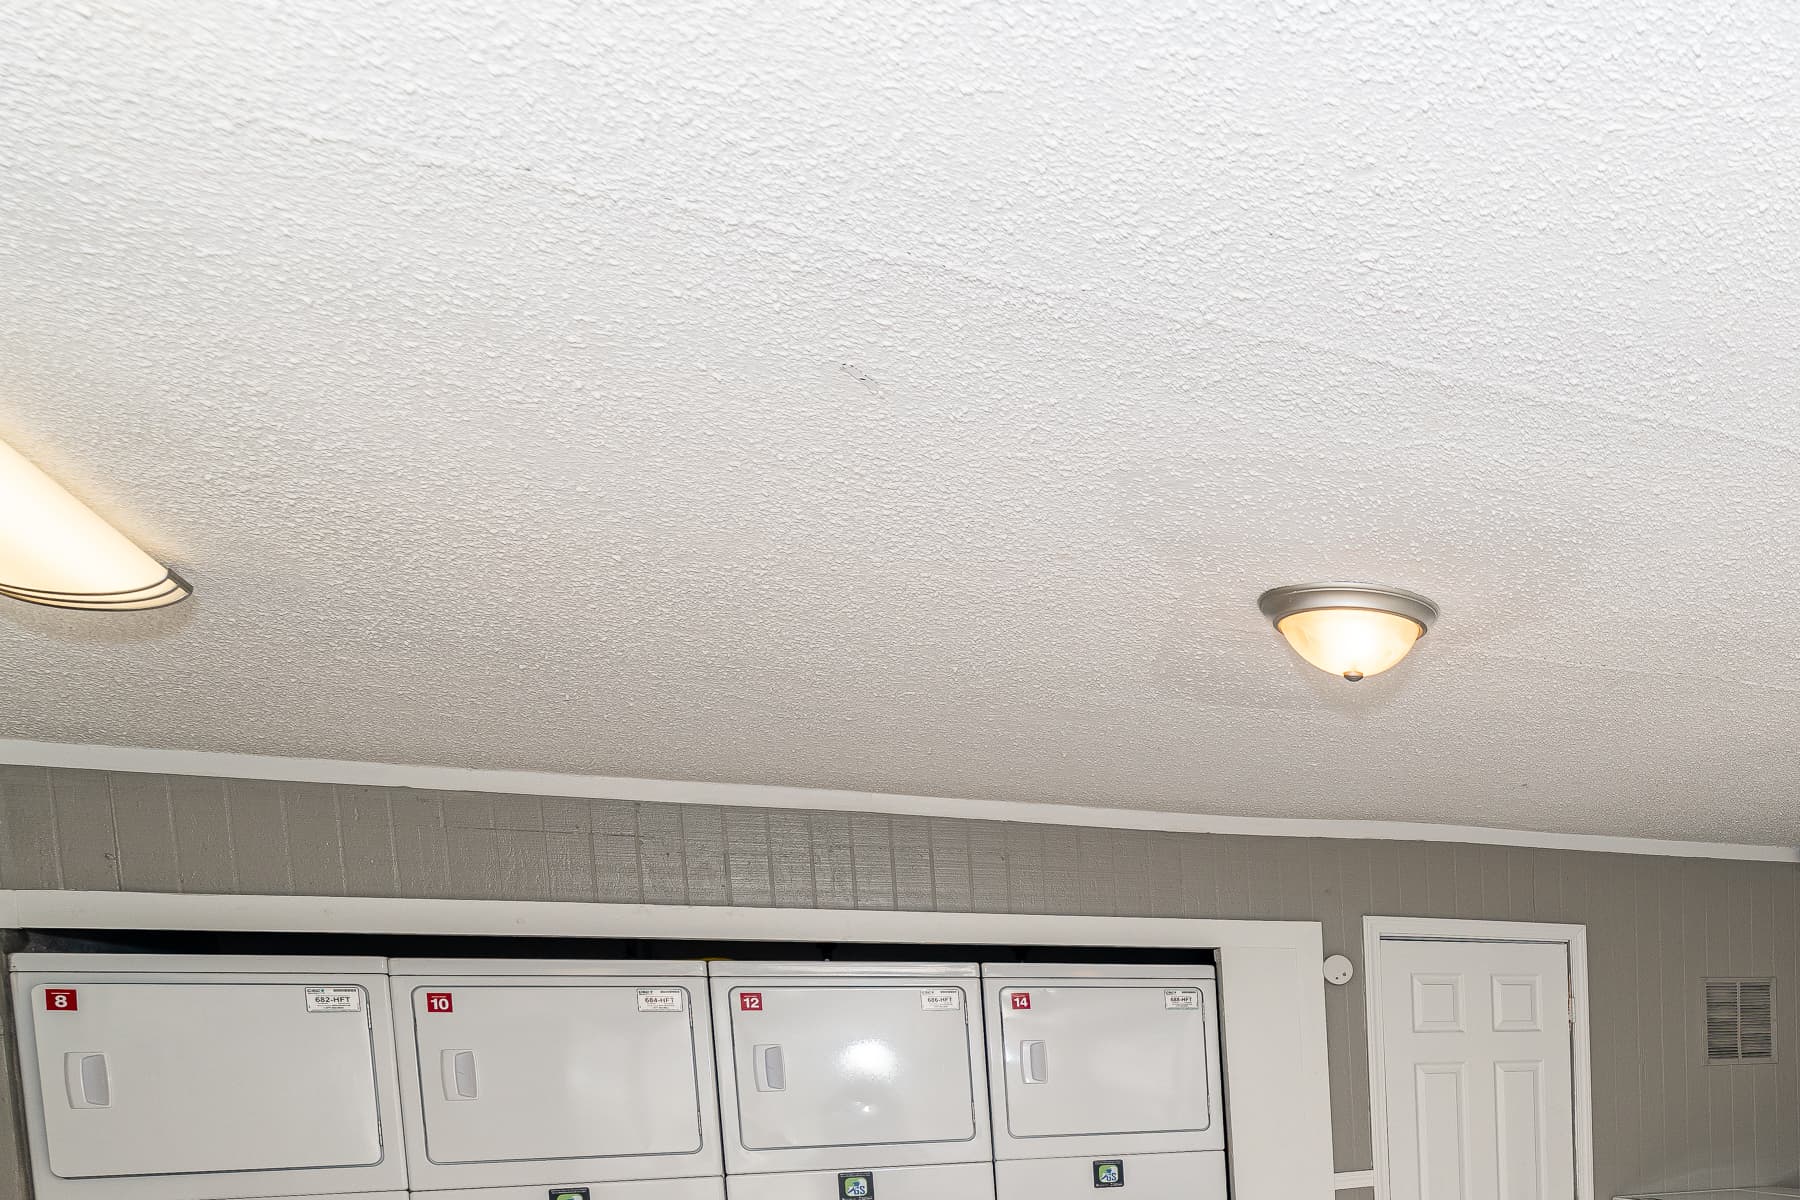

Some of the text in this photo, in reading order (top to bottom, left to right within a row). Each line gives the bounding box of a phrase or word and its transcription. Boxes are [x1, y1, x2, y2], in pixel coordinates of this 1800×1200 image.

[54, 995, 68, 1008] 8
[430, 998, 449, 1010] 10
[743, 997, 760, 1009] 12
[1013, 997, 1028, 1008] 14
